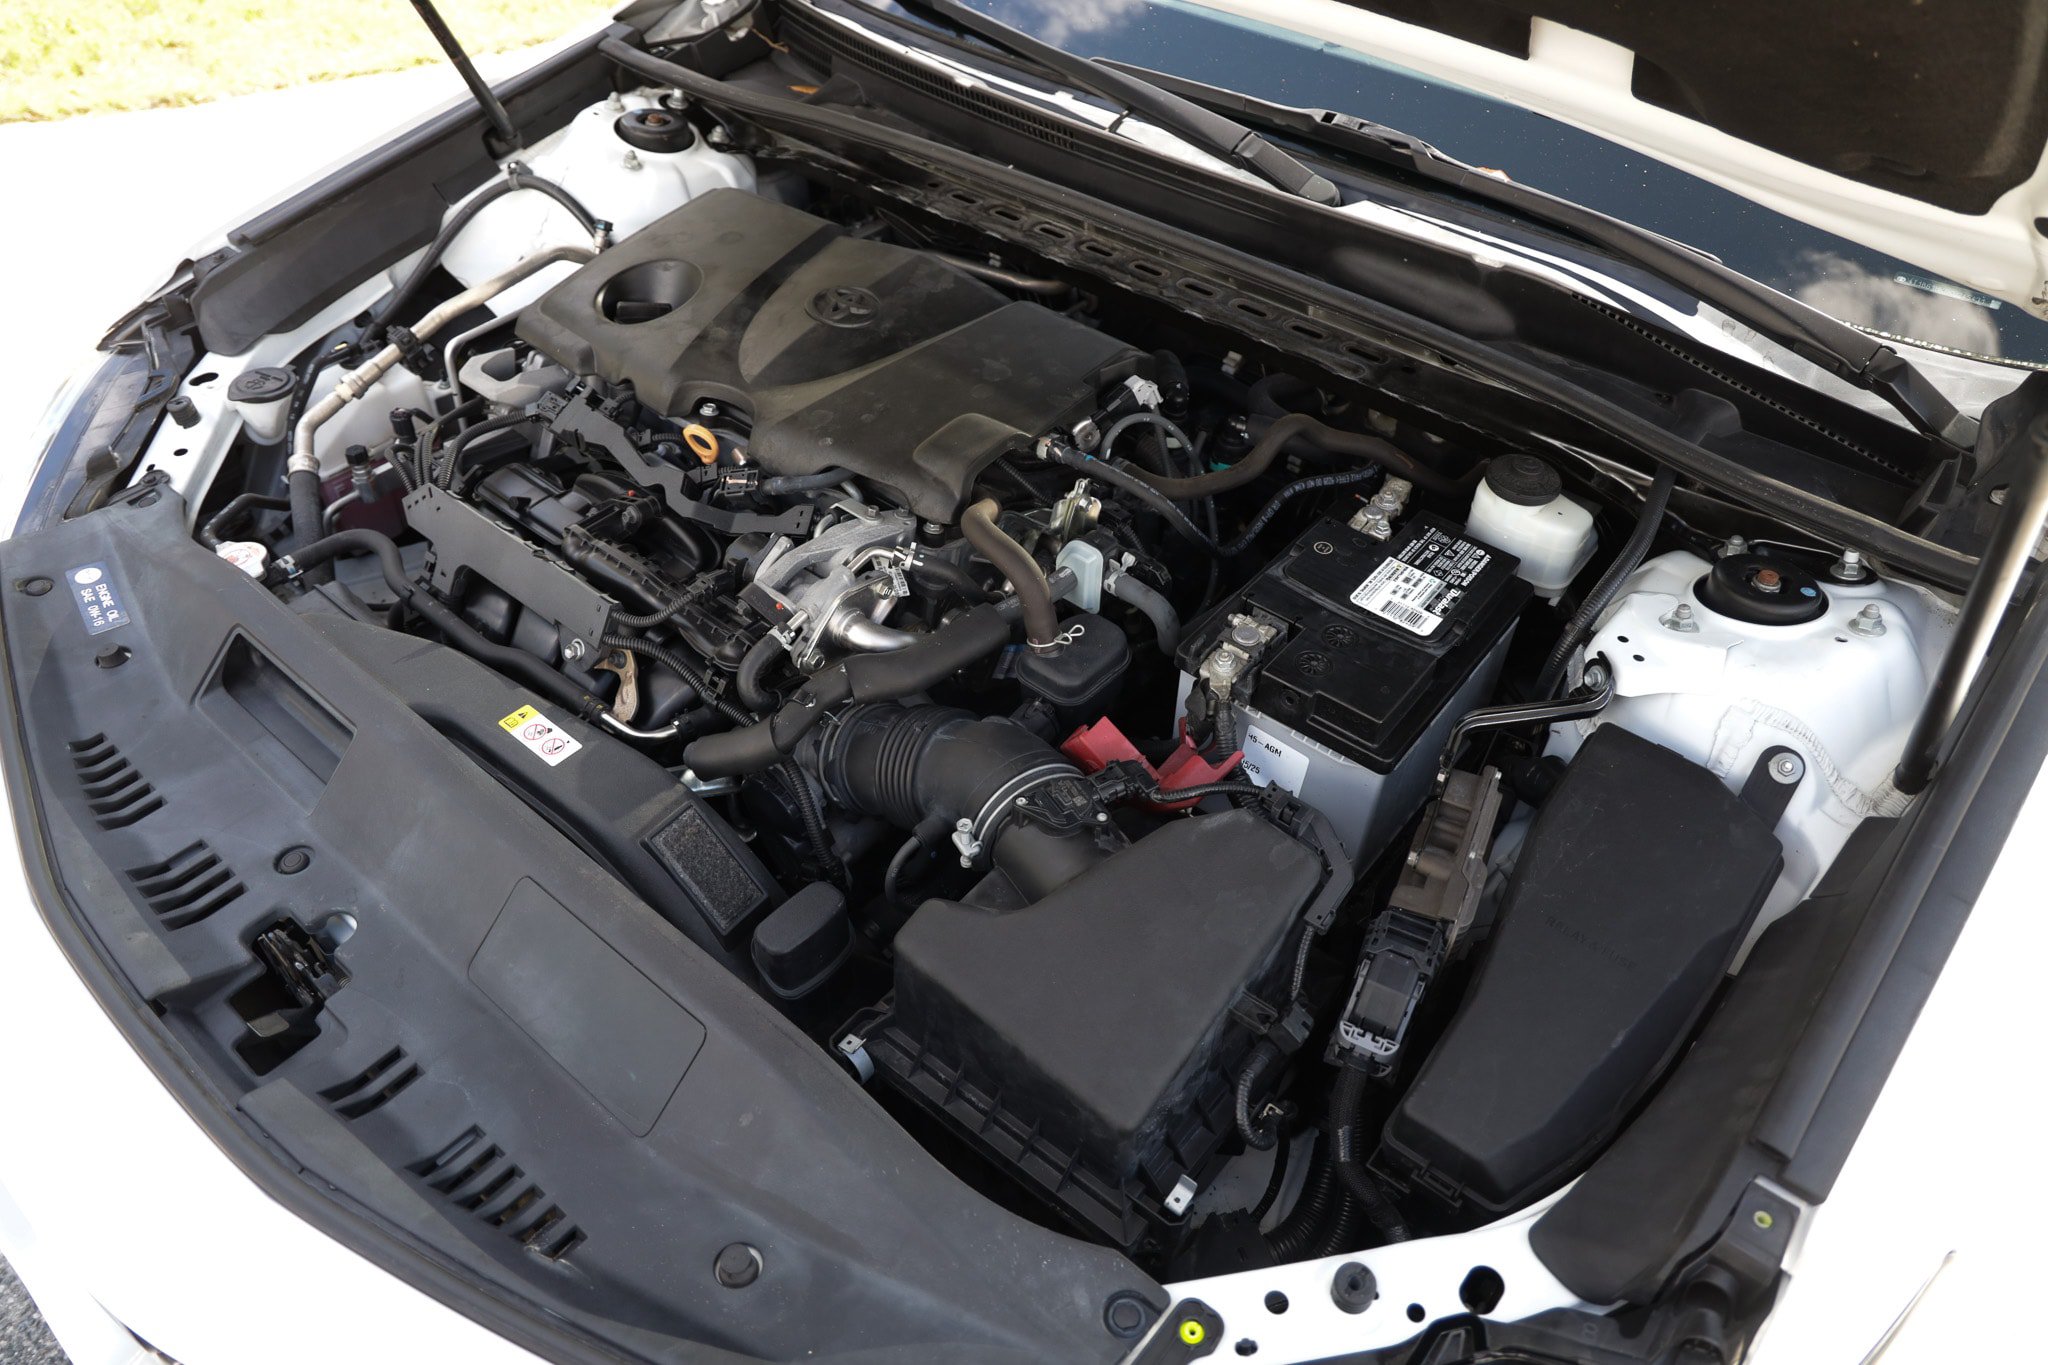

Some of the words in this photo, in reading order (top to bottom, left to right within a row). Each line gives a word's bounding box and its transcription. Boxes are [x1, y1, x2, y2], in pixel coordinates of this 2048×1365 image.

[80, 588, 96, 604] SAE
[95, 583, 115, 608] ENGINE
[106, 609, 120, 622] OIL
[1433, 588, 1461, 616] Duralast
[87, 605, 105, 627] 0W-16
